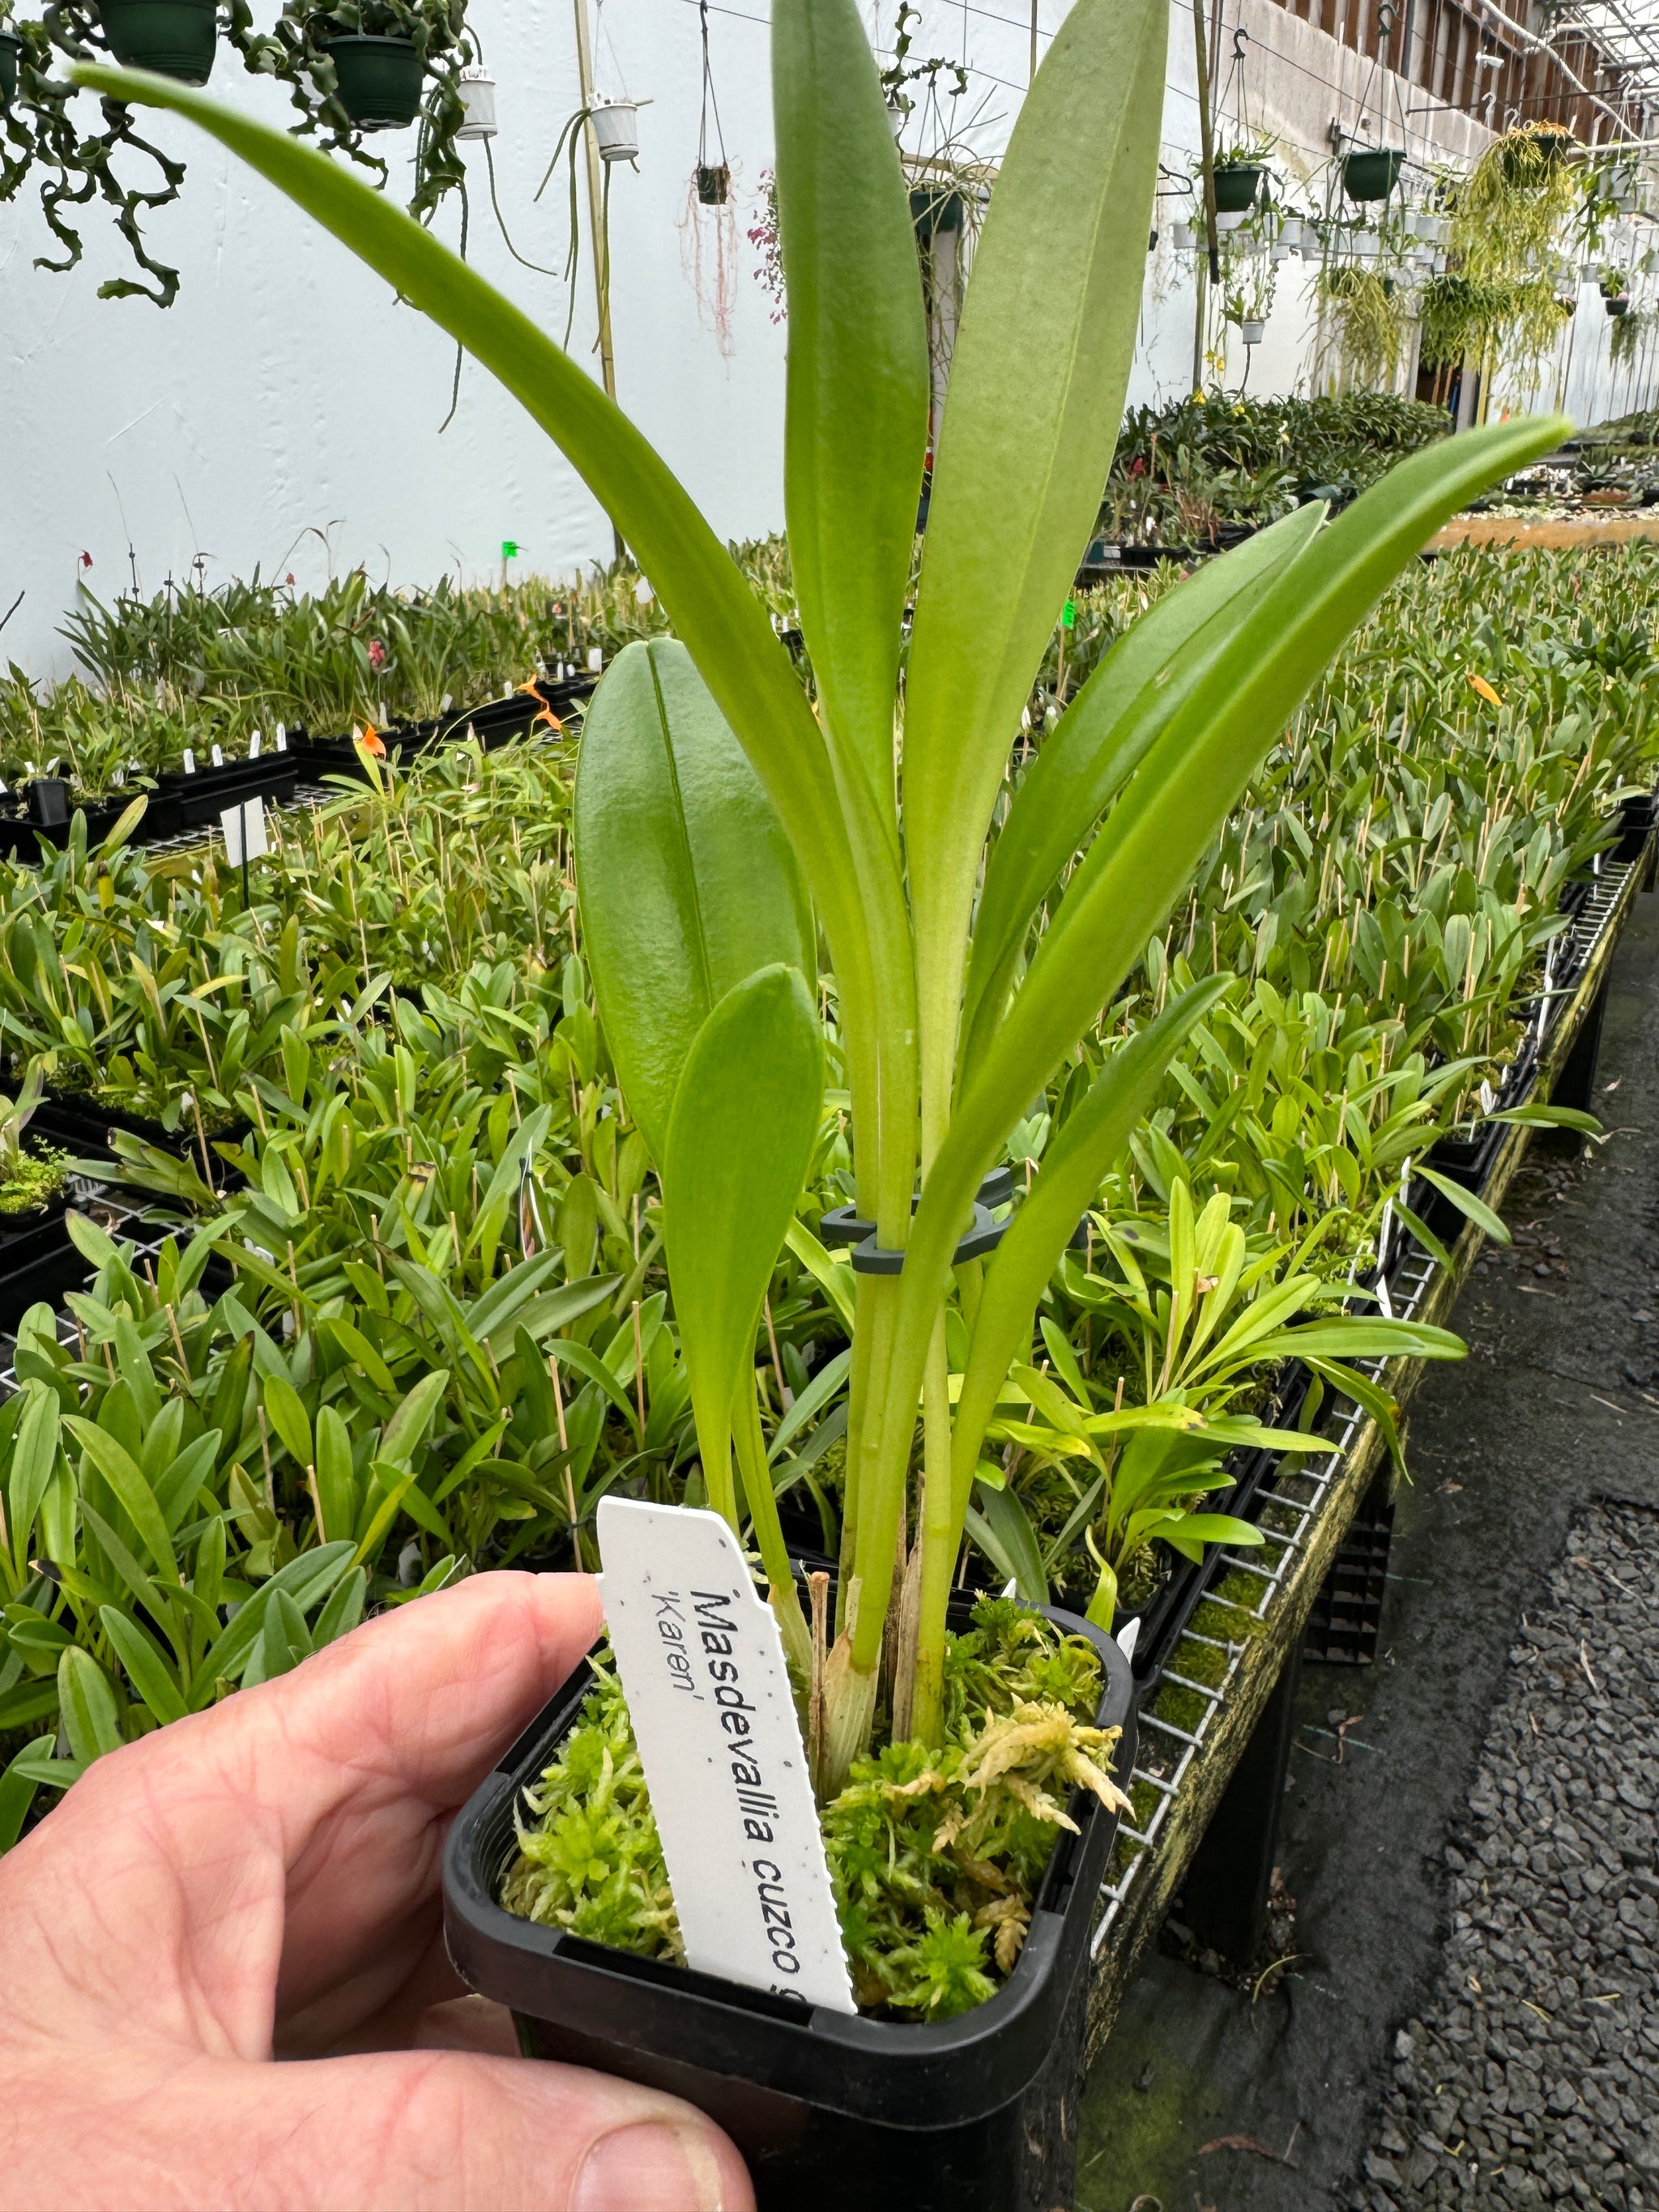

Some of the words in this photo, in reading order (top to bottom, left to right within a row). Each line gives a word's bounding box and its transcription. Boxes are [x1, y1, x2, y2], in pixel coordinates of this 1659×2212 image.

[651, 1591, 704, 1700] 'Karen'
[690, 1591, 779, 1843] Masdevallia
[753, 1860, 800, 1973] cuzco
